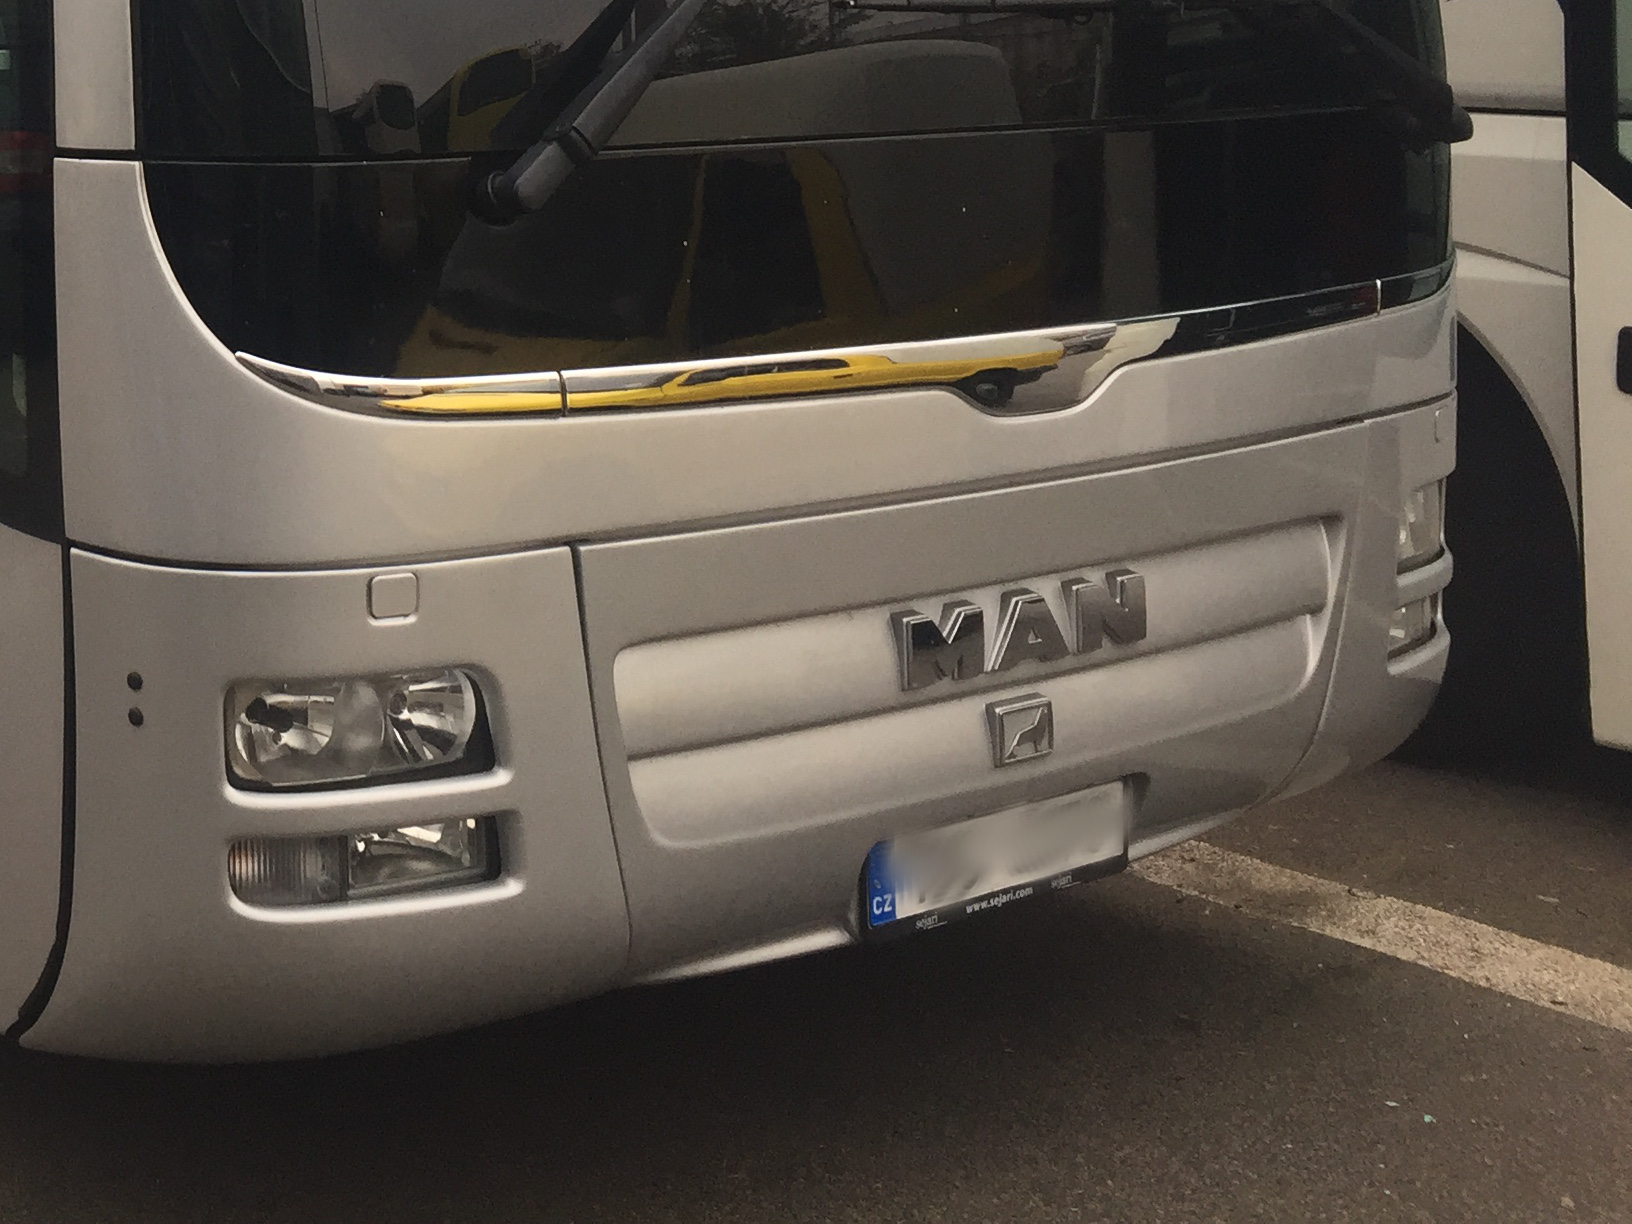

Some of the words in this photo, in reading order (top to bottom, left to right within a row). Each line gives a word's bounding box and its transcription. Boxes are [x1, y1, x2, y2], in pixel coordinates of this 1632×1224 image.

[889, 568, 1148, 692] MAN
[872, 893, 894, 916] CZ
[965, 885, 1034, 914] www.sejari.com
